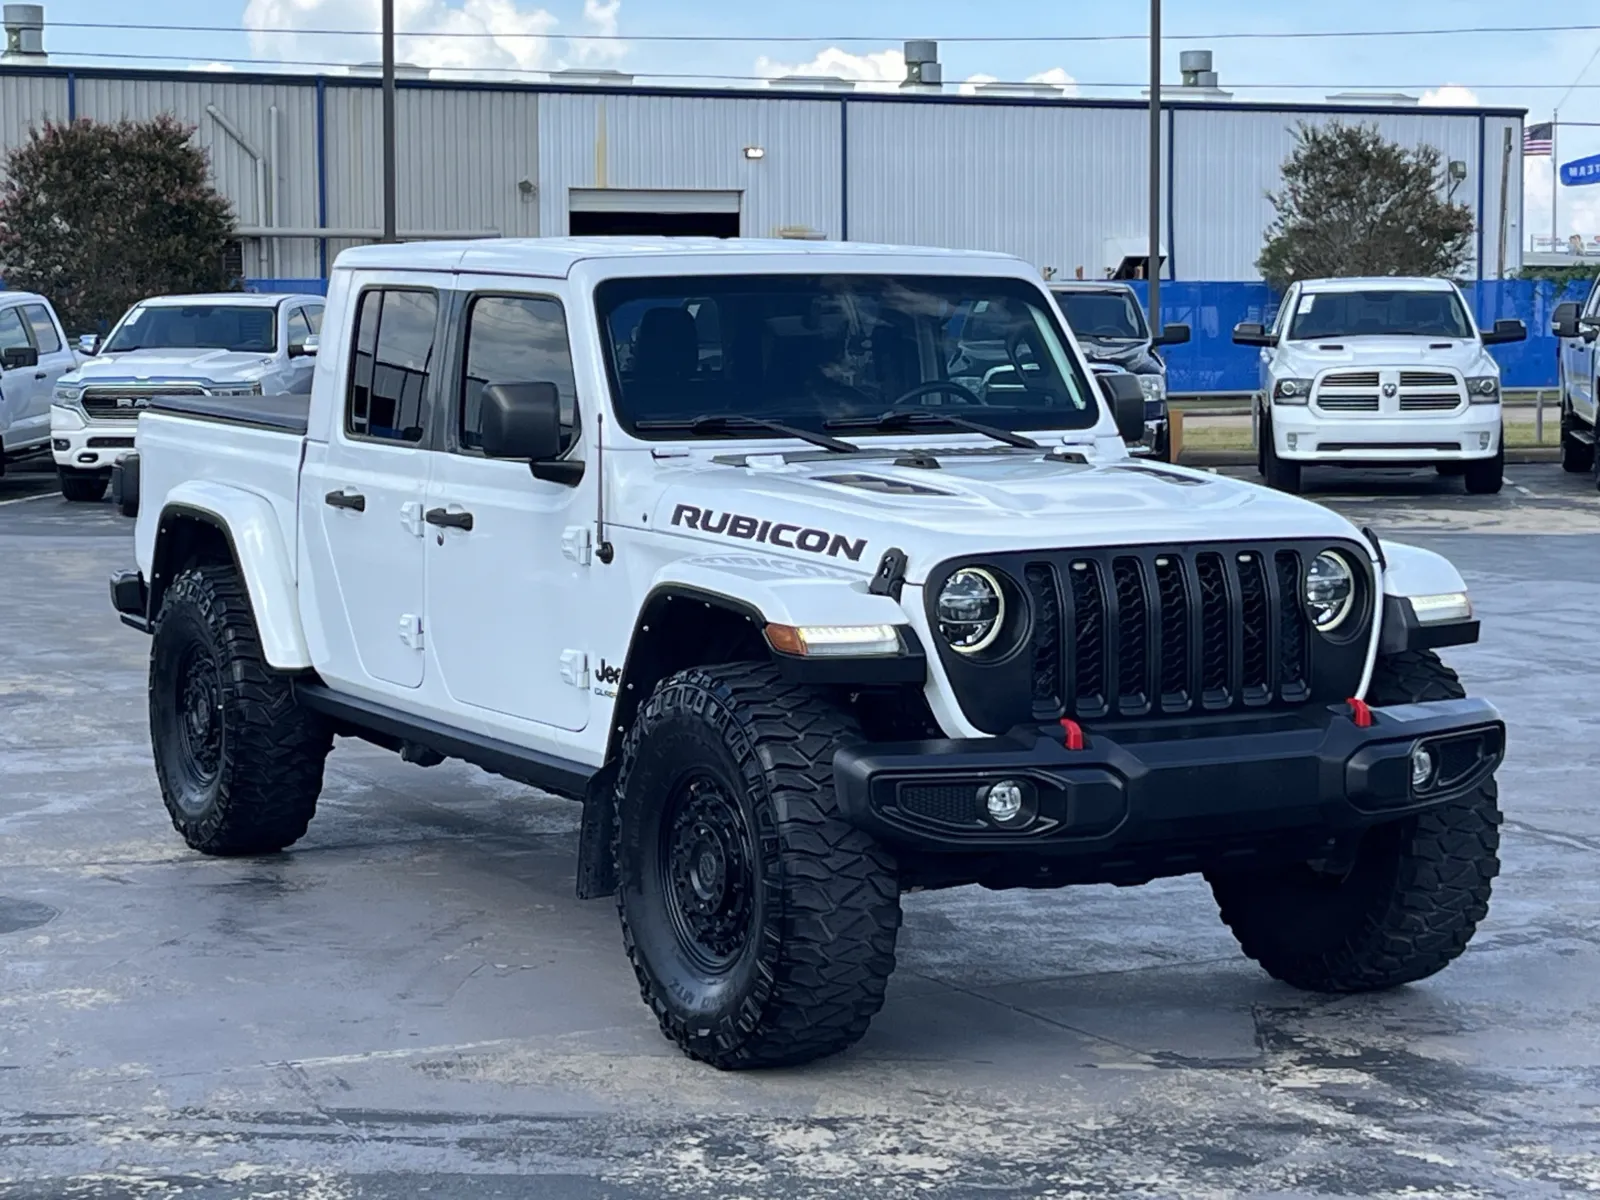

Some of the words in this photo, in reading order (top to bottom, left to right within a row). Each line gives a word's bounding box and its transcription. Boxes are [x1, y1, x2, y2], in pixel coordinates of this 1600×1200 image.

[116, 398, 150, 408] RA
[670, 503, 868, 562] RUBICON
[594, 658, 622, 685] Jee
